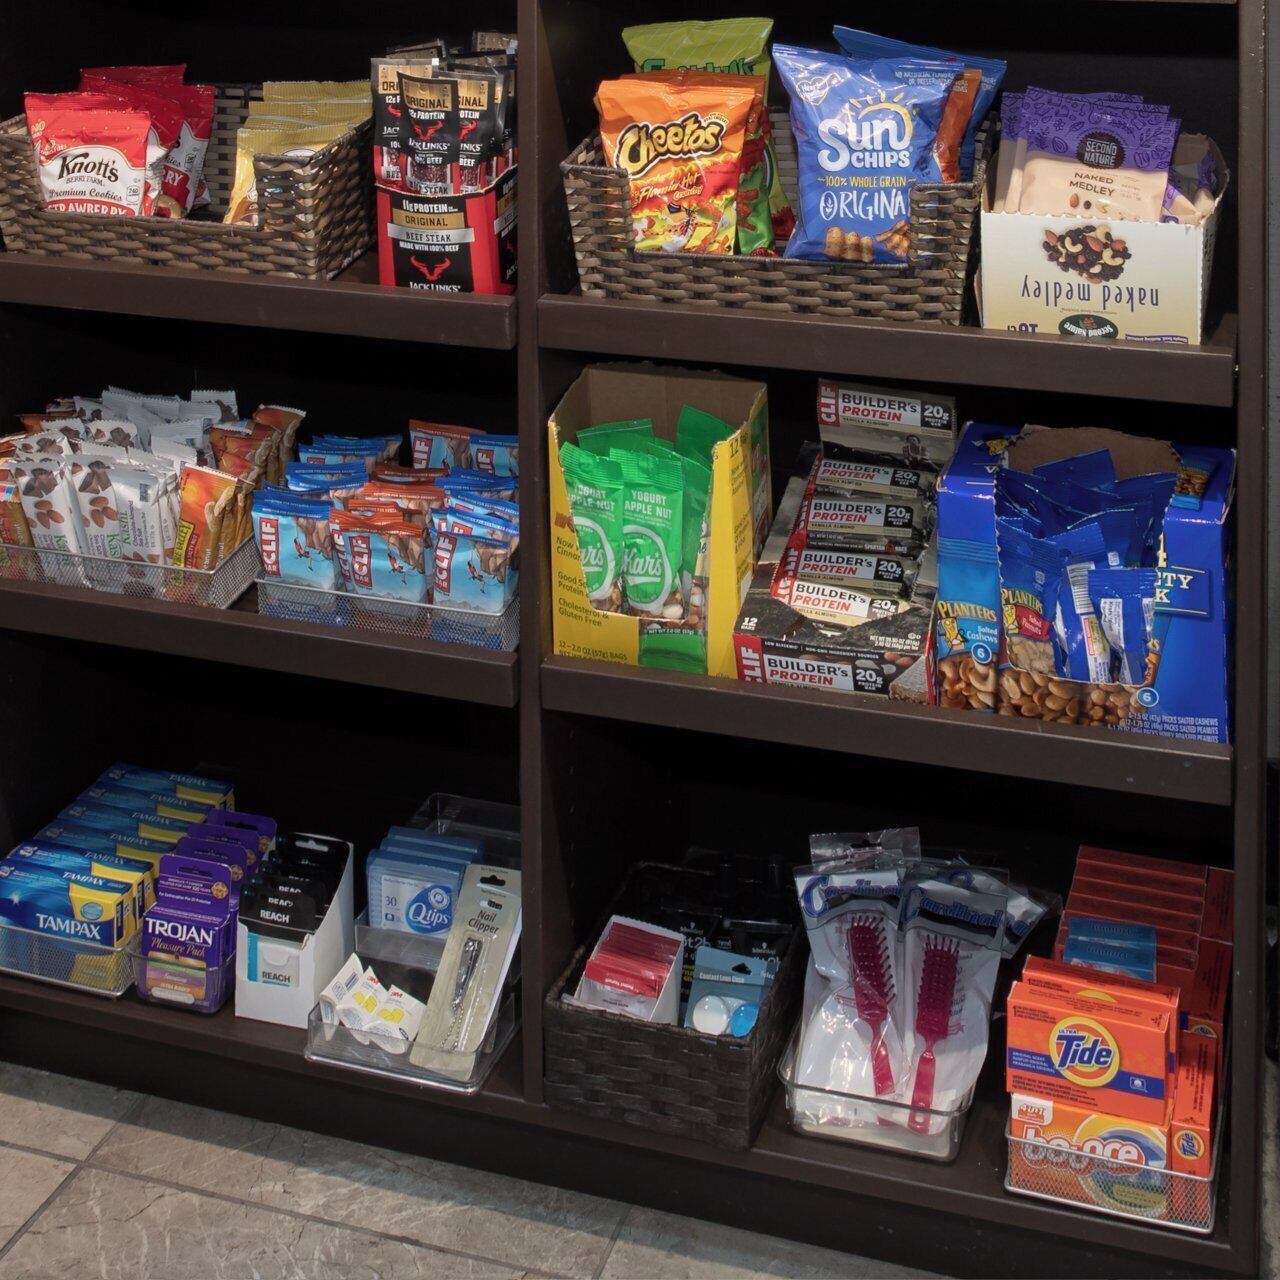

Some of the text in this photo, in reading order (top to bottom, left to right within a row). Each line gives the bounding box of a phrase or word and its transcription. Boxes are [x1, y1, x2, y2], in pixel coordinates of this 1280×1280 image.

[616, 115, 723, 178] Cheetos
[817, 115, 905, 172] Sun
[1085, 141, 1117, 155] SECOND
[851, 150, 911, 168] CHIPS
[1084, 152, 1116, 166] NATURE
[57, 152, 119, 184] Knott's
[825, 175, 907, 188] 100% WHOLE GRAIN
[1074, 172, 1114, 184] NAKED
[89, 189, 123, 202] Cookies
[1069, 181, 1116, 197] MEDLEY
[413, 201, 448, 213] PROTEIN
[405, 216, 448, 227] ORIGINAL
[405, 231, 451, 243] BEEF STEAK
[1022, 275, 1159, 312] naked medley
[842, 406, 902, 423] PROTEIN
[923, 405, 949, 421] 20g
[632, 489, 666, 505] YOGURT
[625, 501, 673, 519] APPLE NUT
[937, 600, 997, 621] PLANTERS
[966, 630, 998, 644] Cashews
[977, 625, 998, 636] Salted
[769, 670, 834, 686] PROTEIN
[855, 669, 883, 683] 20g
[259, 909, 290, 924] REACH
[477, 909, 497, 923] Nail
[36, 913, 101, 940] TAMPAX
[145, 918, 214, 946] TROJAN
[468, 917, 499, 935] Clipper
[1054, 1032, 1114, 1070] Tide
